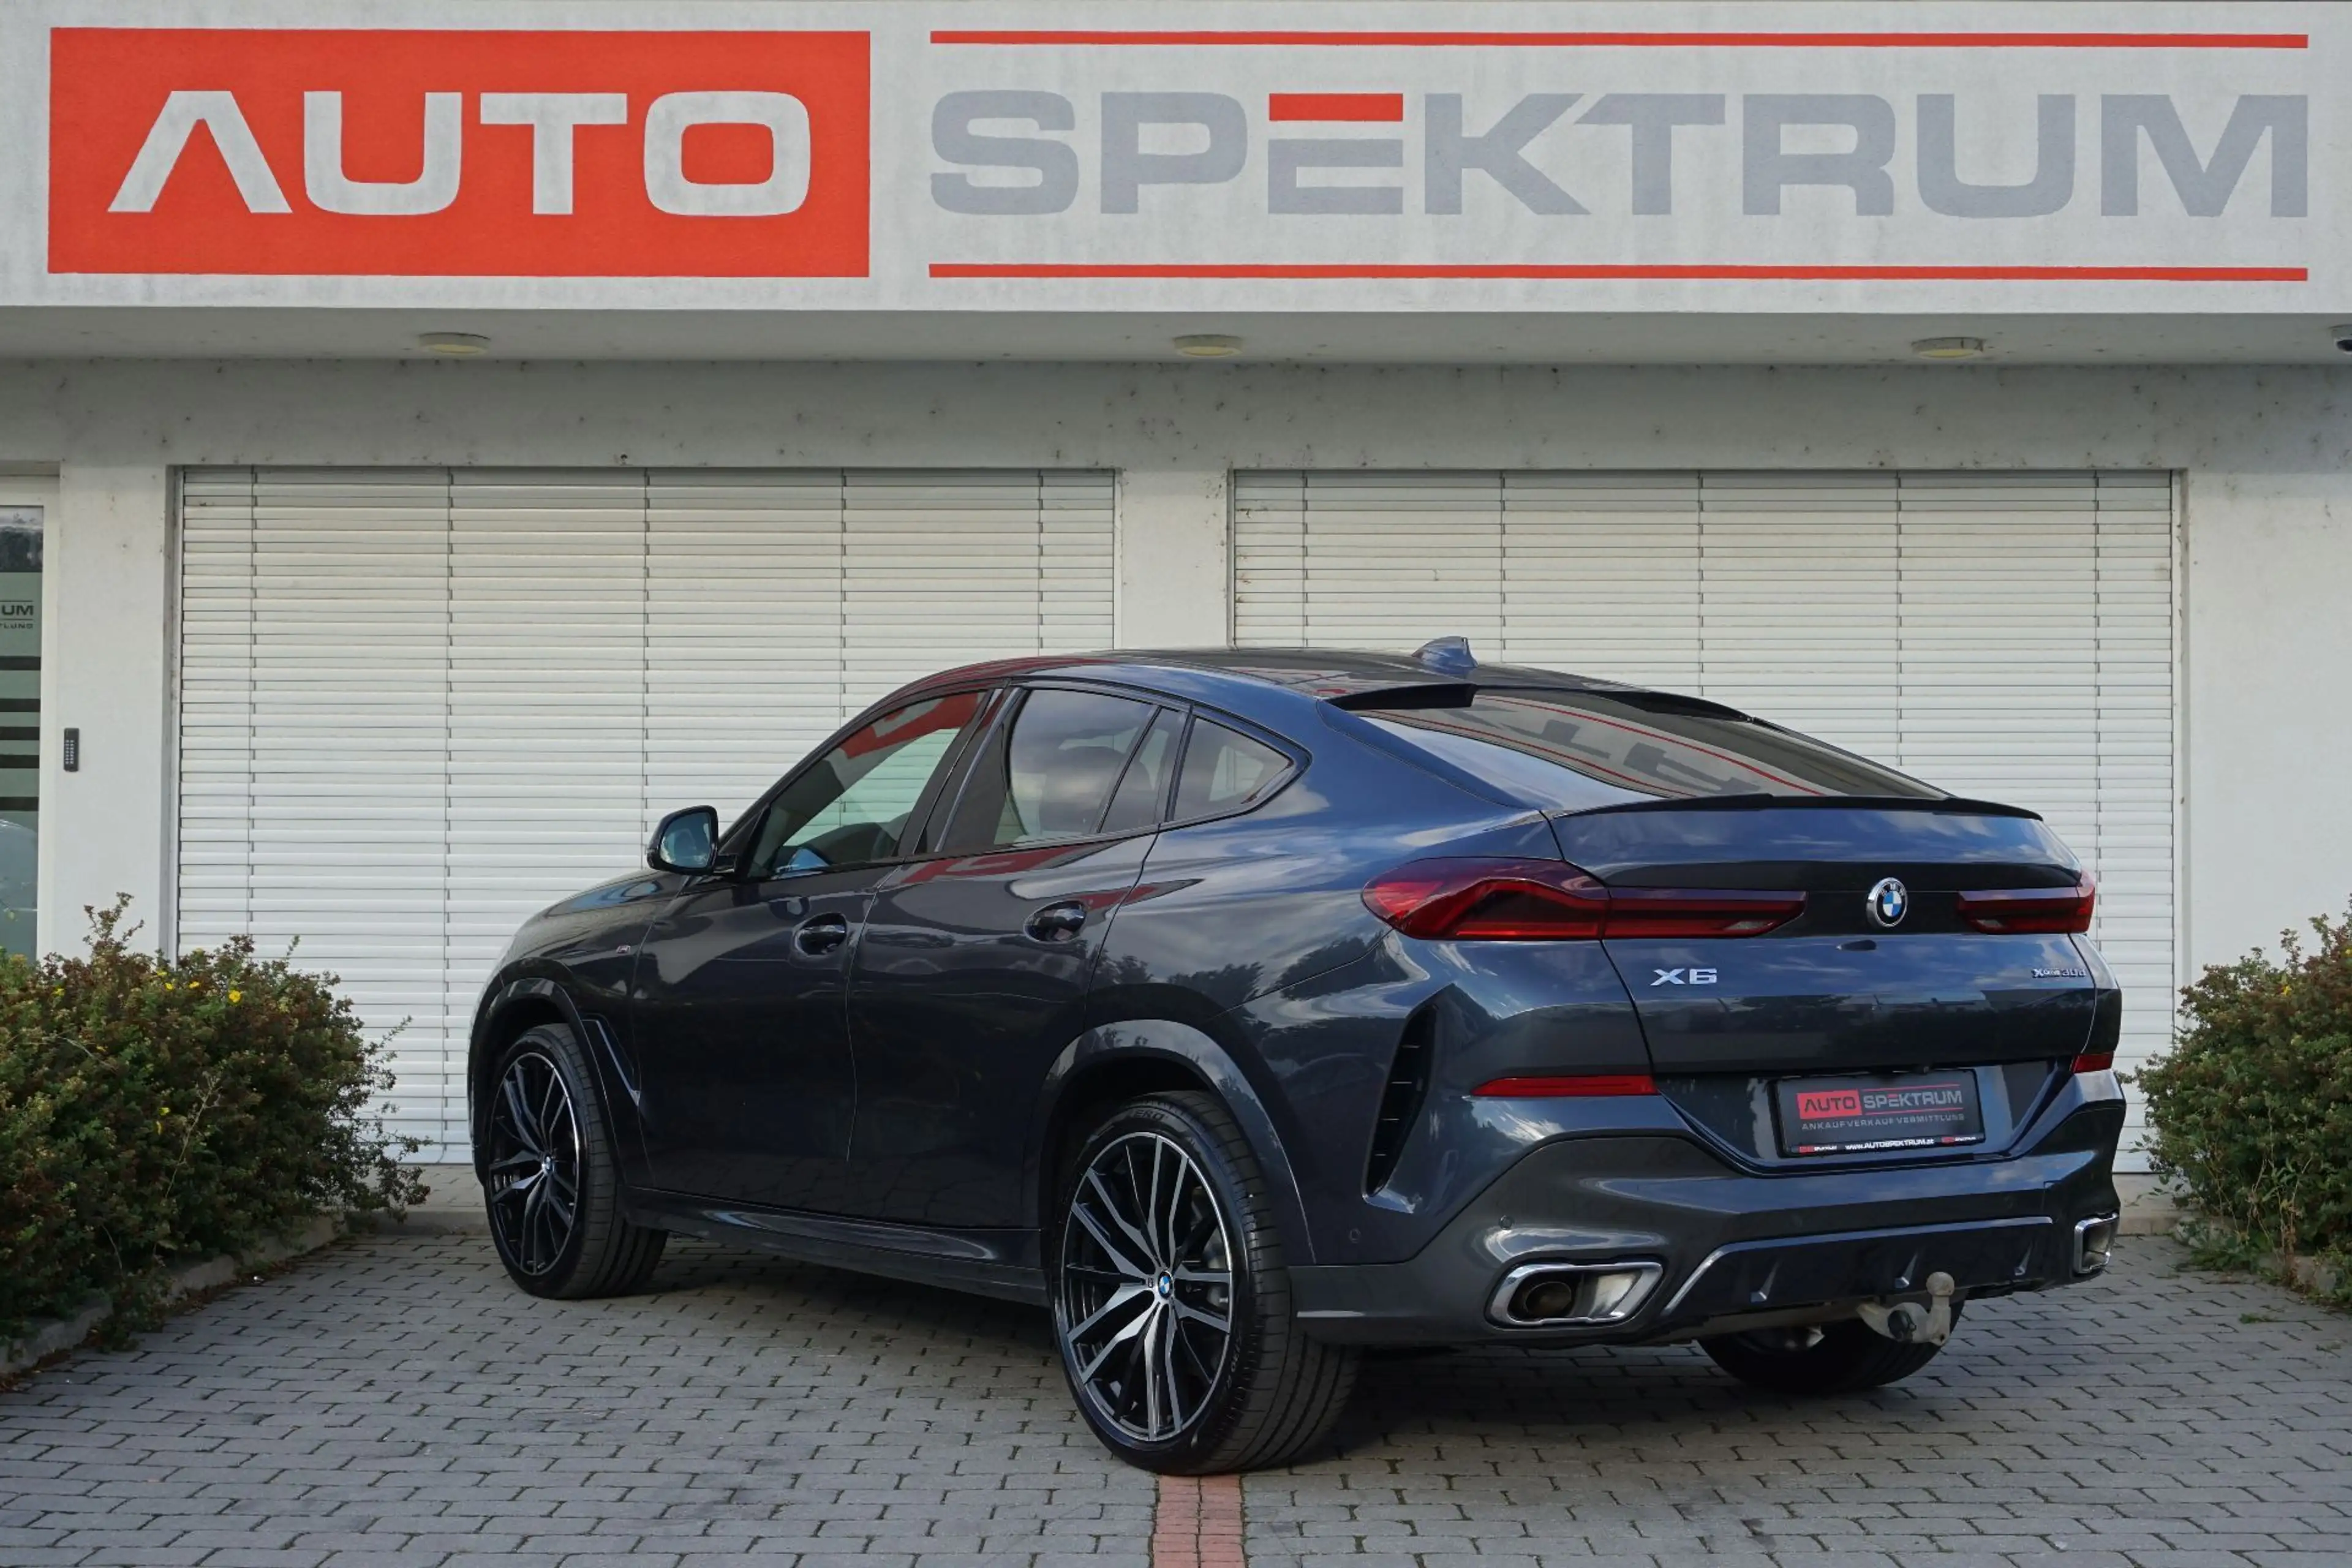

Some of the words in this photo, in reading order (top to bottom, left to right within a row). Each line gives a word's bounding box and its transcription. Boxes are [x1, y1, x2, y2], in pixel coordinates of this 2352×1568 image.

[108, 91, 810, 216] AUTO
[931, 90, 2307, 217] SPEKTRUM
[1651, 968, 1717, 986] X6
[1804, 1096, 1856, 1112] AUTO
[1864, 1090, 1962, 1109] SPEKTRUM
